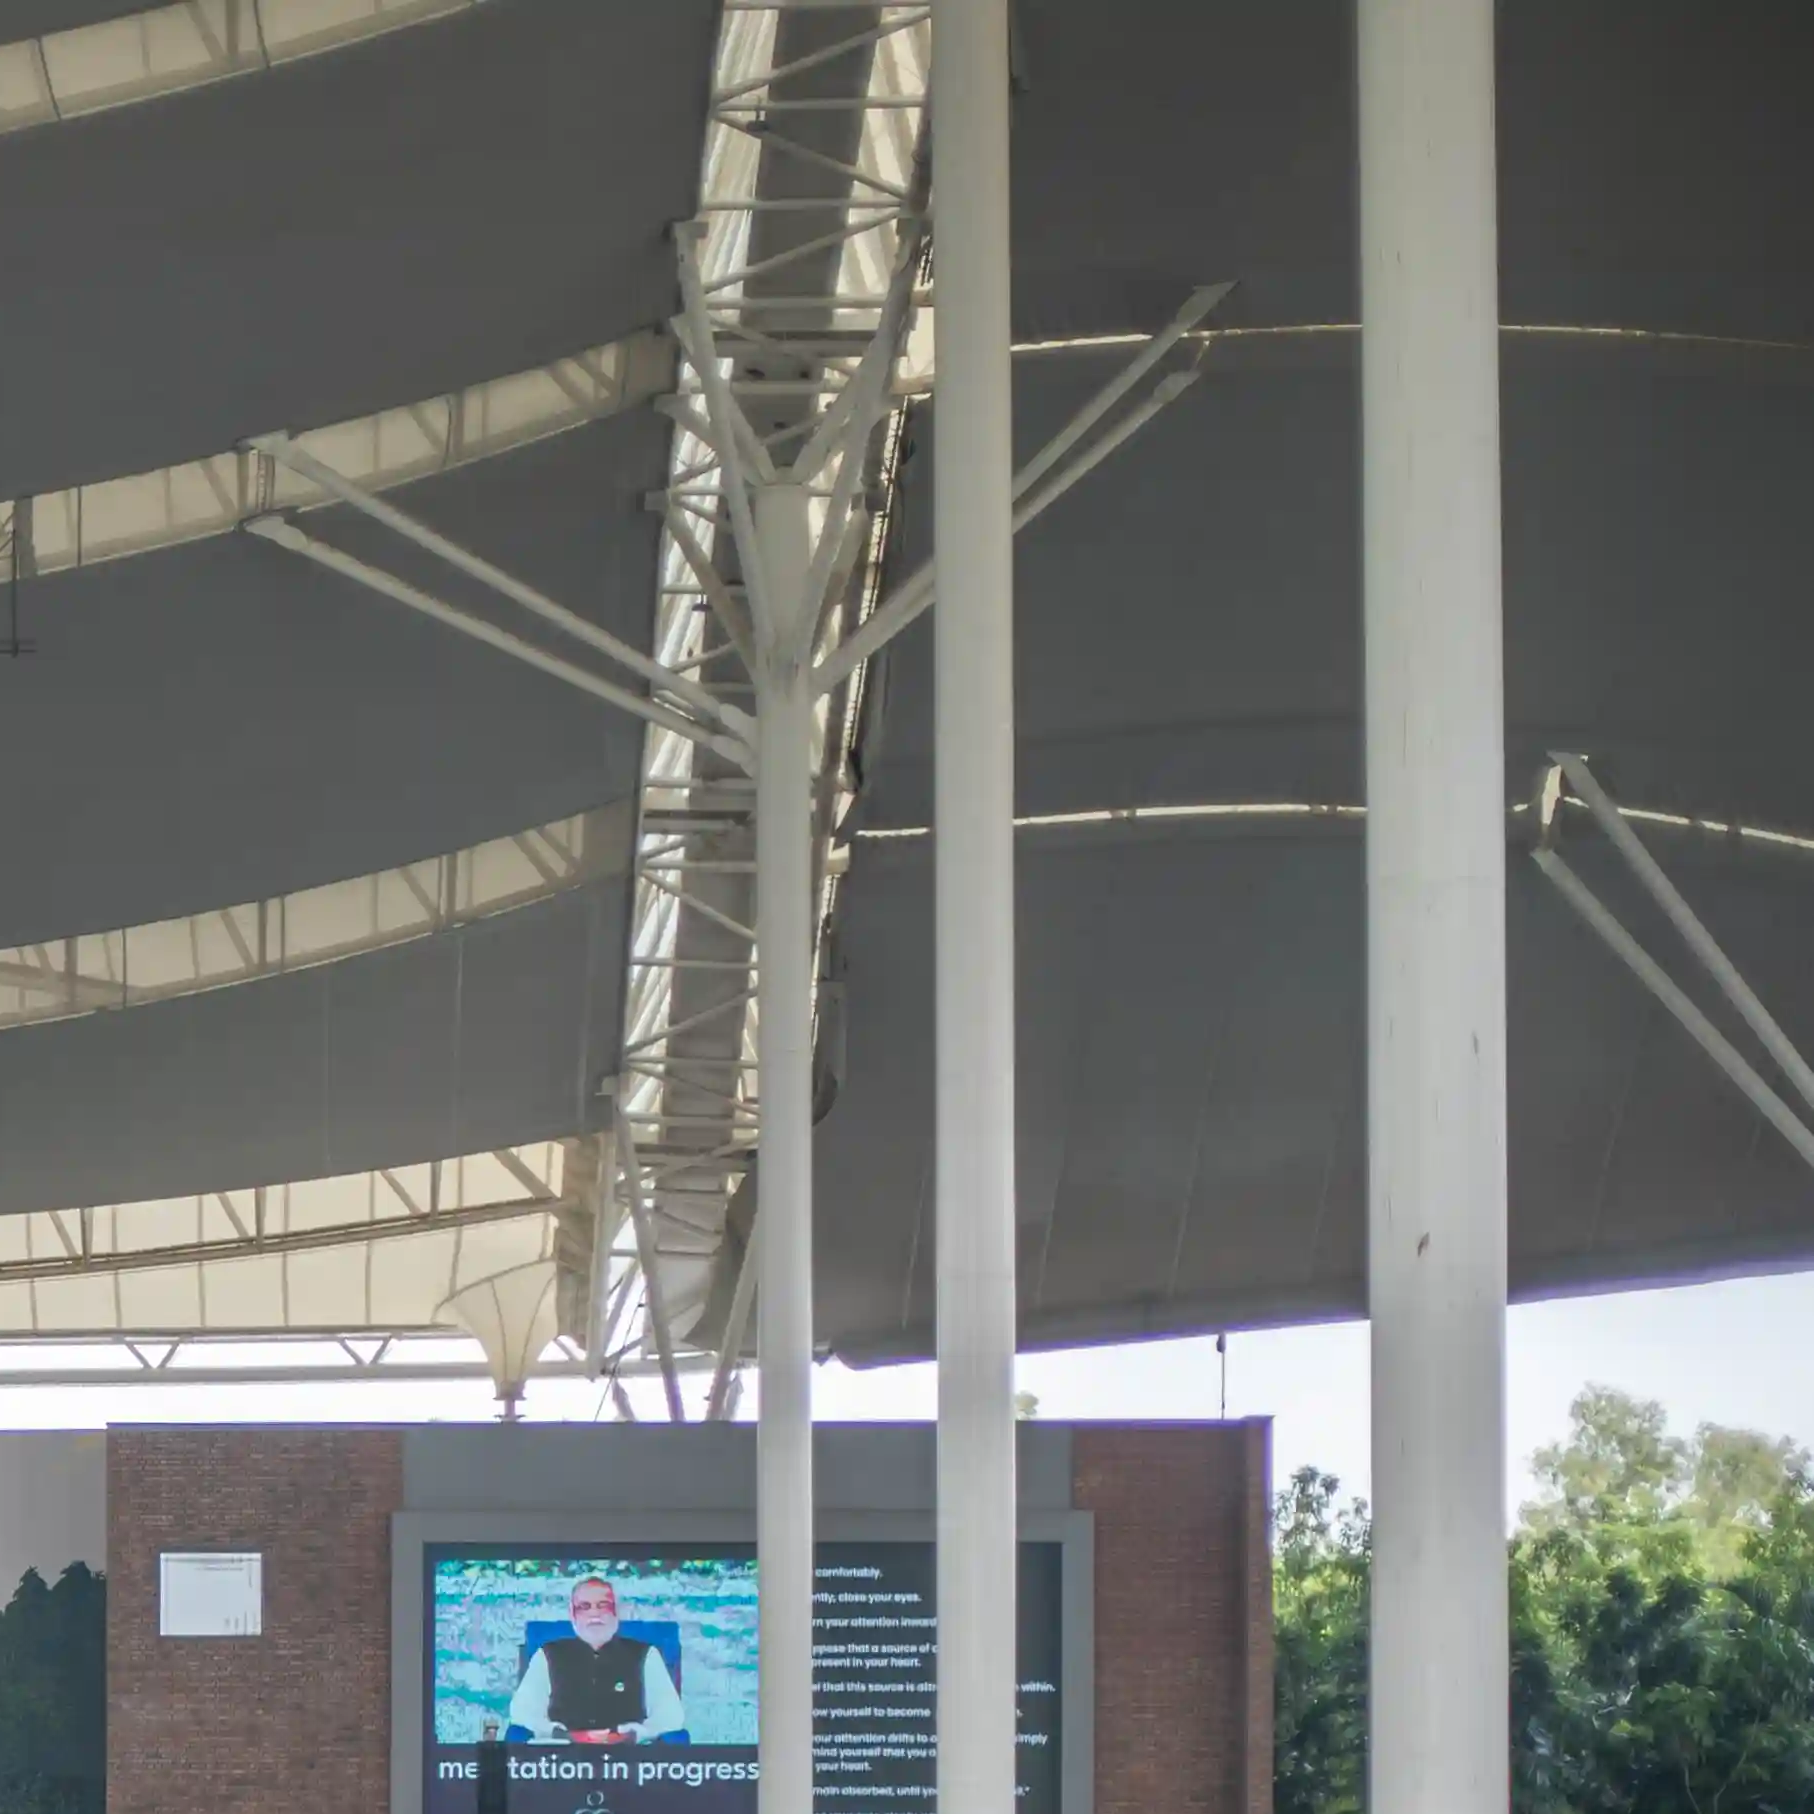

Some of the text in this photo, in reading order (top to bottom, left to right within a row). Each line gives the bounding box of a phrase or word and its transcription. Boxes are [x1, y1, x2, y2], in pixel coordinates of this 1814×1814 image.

[812, 1592, 836, 1605] ntly,
[901, 1617, 937, 1627] inward
[812, 1644, 845, 1655] ppose
[812, 1734, 832, 1742] our
[812, 1746, 838, 1757] mind
[438, 1754, 760, 1787] metation in progress
[812, 1786, 840, 1796] main
